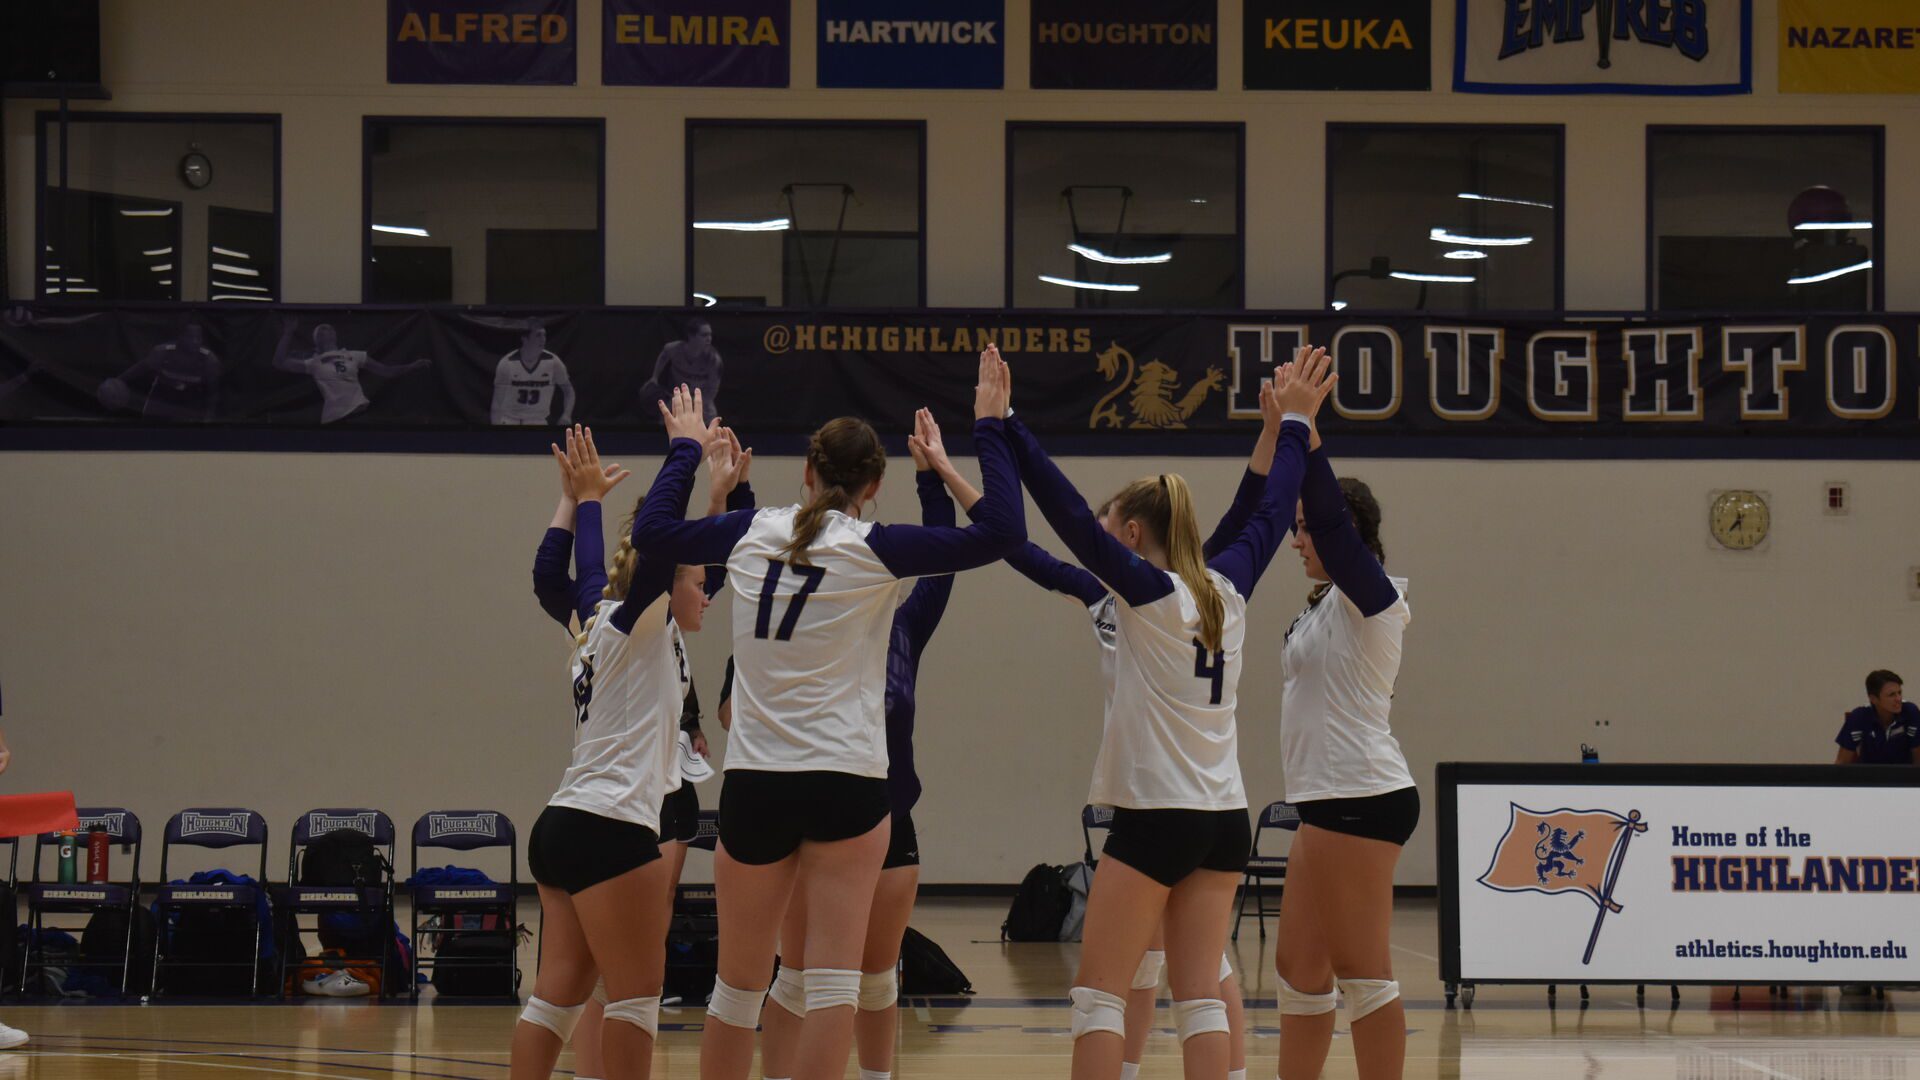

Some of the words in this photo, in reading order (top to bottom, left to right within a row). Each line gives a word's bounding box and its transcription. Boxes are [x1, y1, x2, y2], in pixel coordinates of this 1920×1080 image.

[396, 12, 568, 44] ALFRED
[614, 13, 781, 47] ELMIRA
[825, 19, 997, 45] HARTWICK
[1037, 22, 1212, 45] HOUGHTON
[1264, 17, 1414, 50] KEUKA
[762, 324, 1093, 354] @HCHIGHLANDERS
[1226, 324, 1920, 421] HOUGHTO
[755, 559, 827, 641] 17
[1193, 636, 1225, 705] 4
[184, 815, 246, 834] HOUGHTON
[312, 815, 372, 834] HOUGHTON
[432, 816, 492, 835] HOUGHTON
[1671, 825, 1737, 847] Home
[1745, 826, 1767, 847] of
[1774, 826, 1811, 847] the
[1671, 856, 1920, 894] HIGHLANDE
[1675, 939, 1908, 963] athletics.houghton.edu
